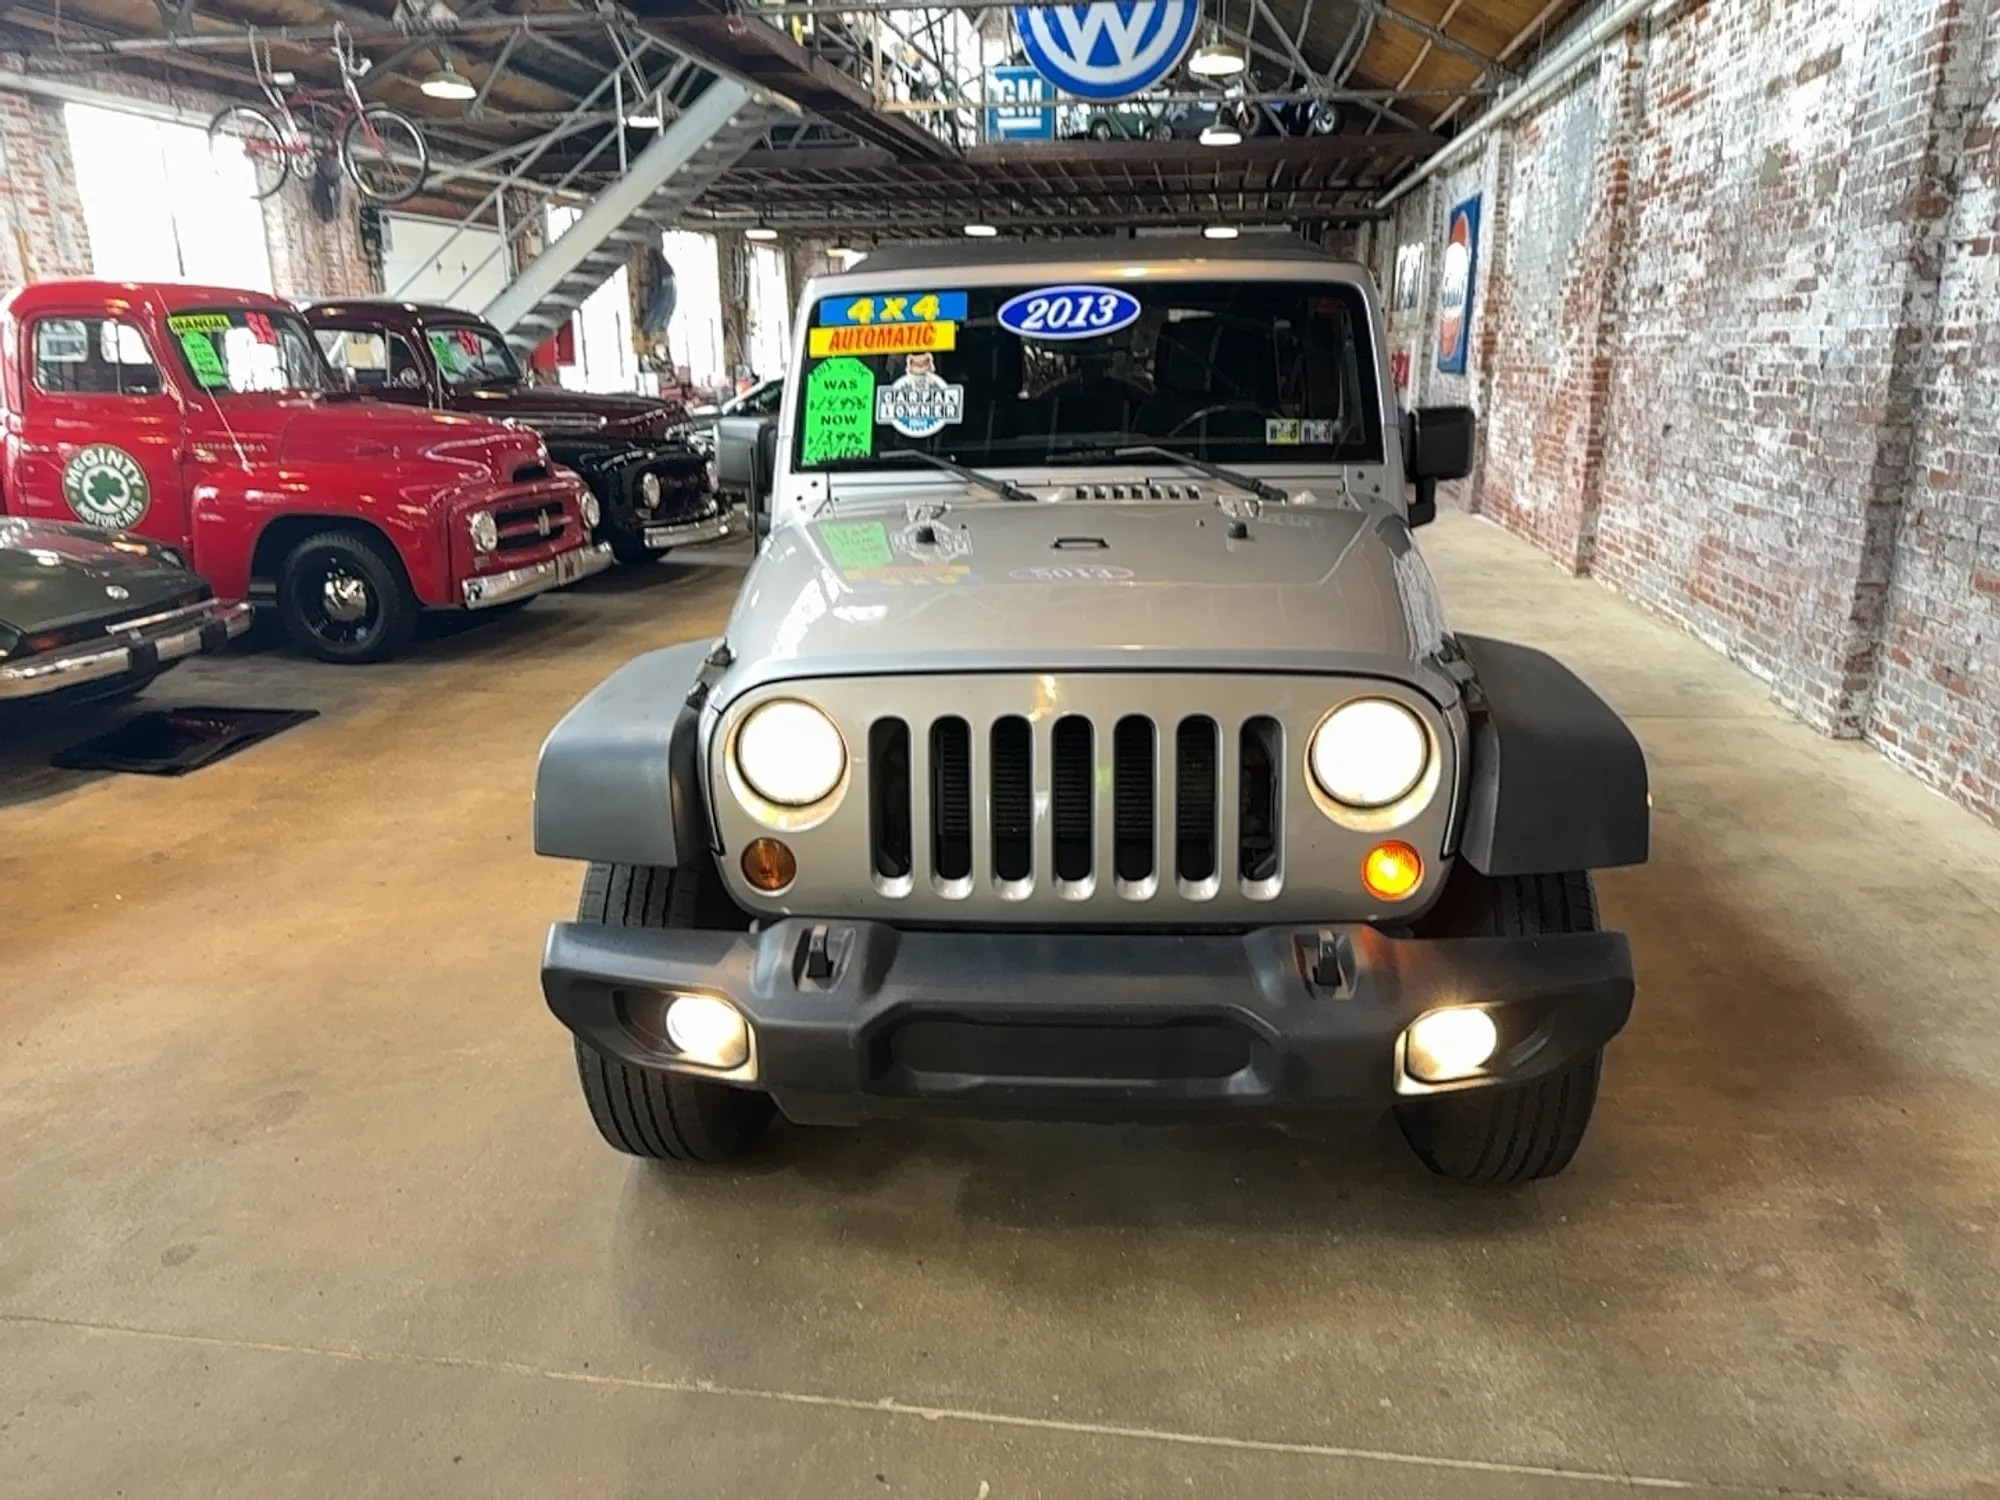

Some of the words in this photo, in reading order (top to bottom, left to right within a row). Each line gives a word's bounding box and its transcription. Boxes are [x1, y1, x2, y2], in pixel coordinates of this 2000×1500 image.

[999, 78, 1042, 116] GM
[1020, 294, 1118, 330] 2013
[828, 325, 936, 350] AUTOMATIC
[824, 379, 858, 391] WAS
[821, 414, 858, 426] NOW
[76, 499, 143, 528] MOTORCARS
